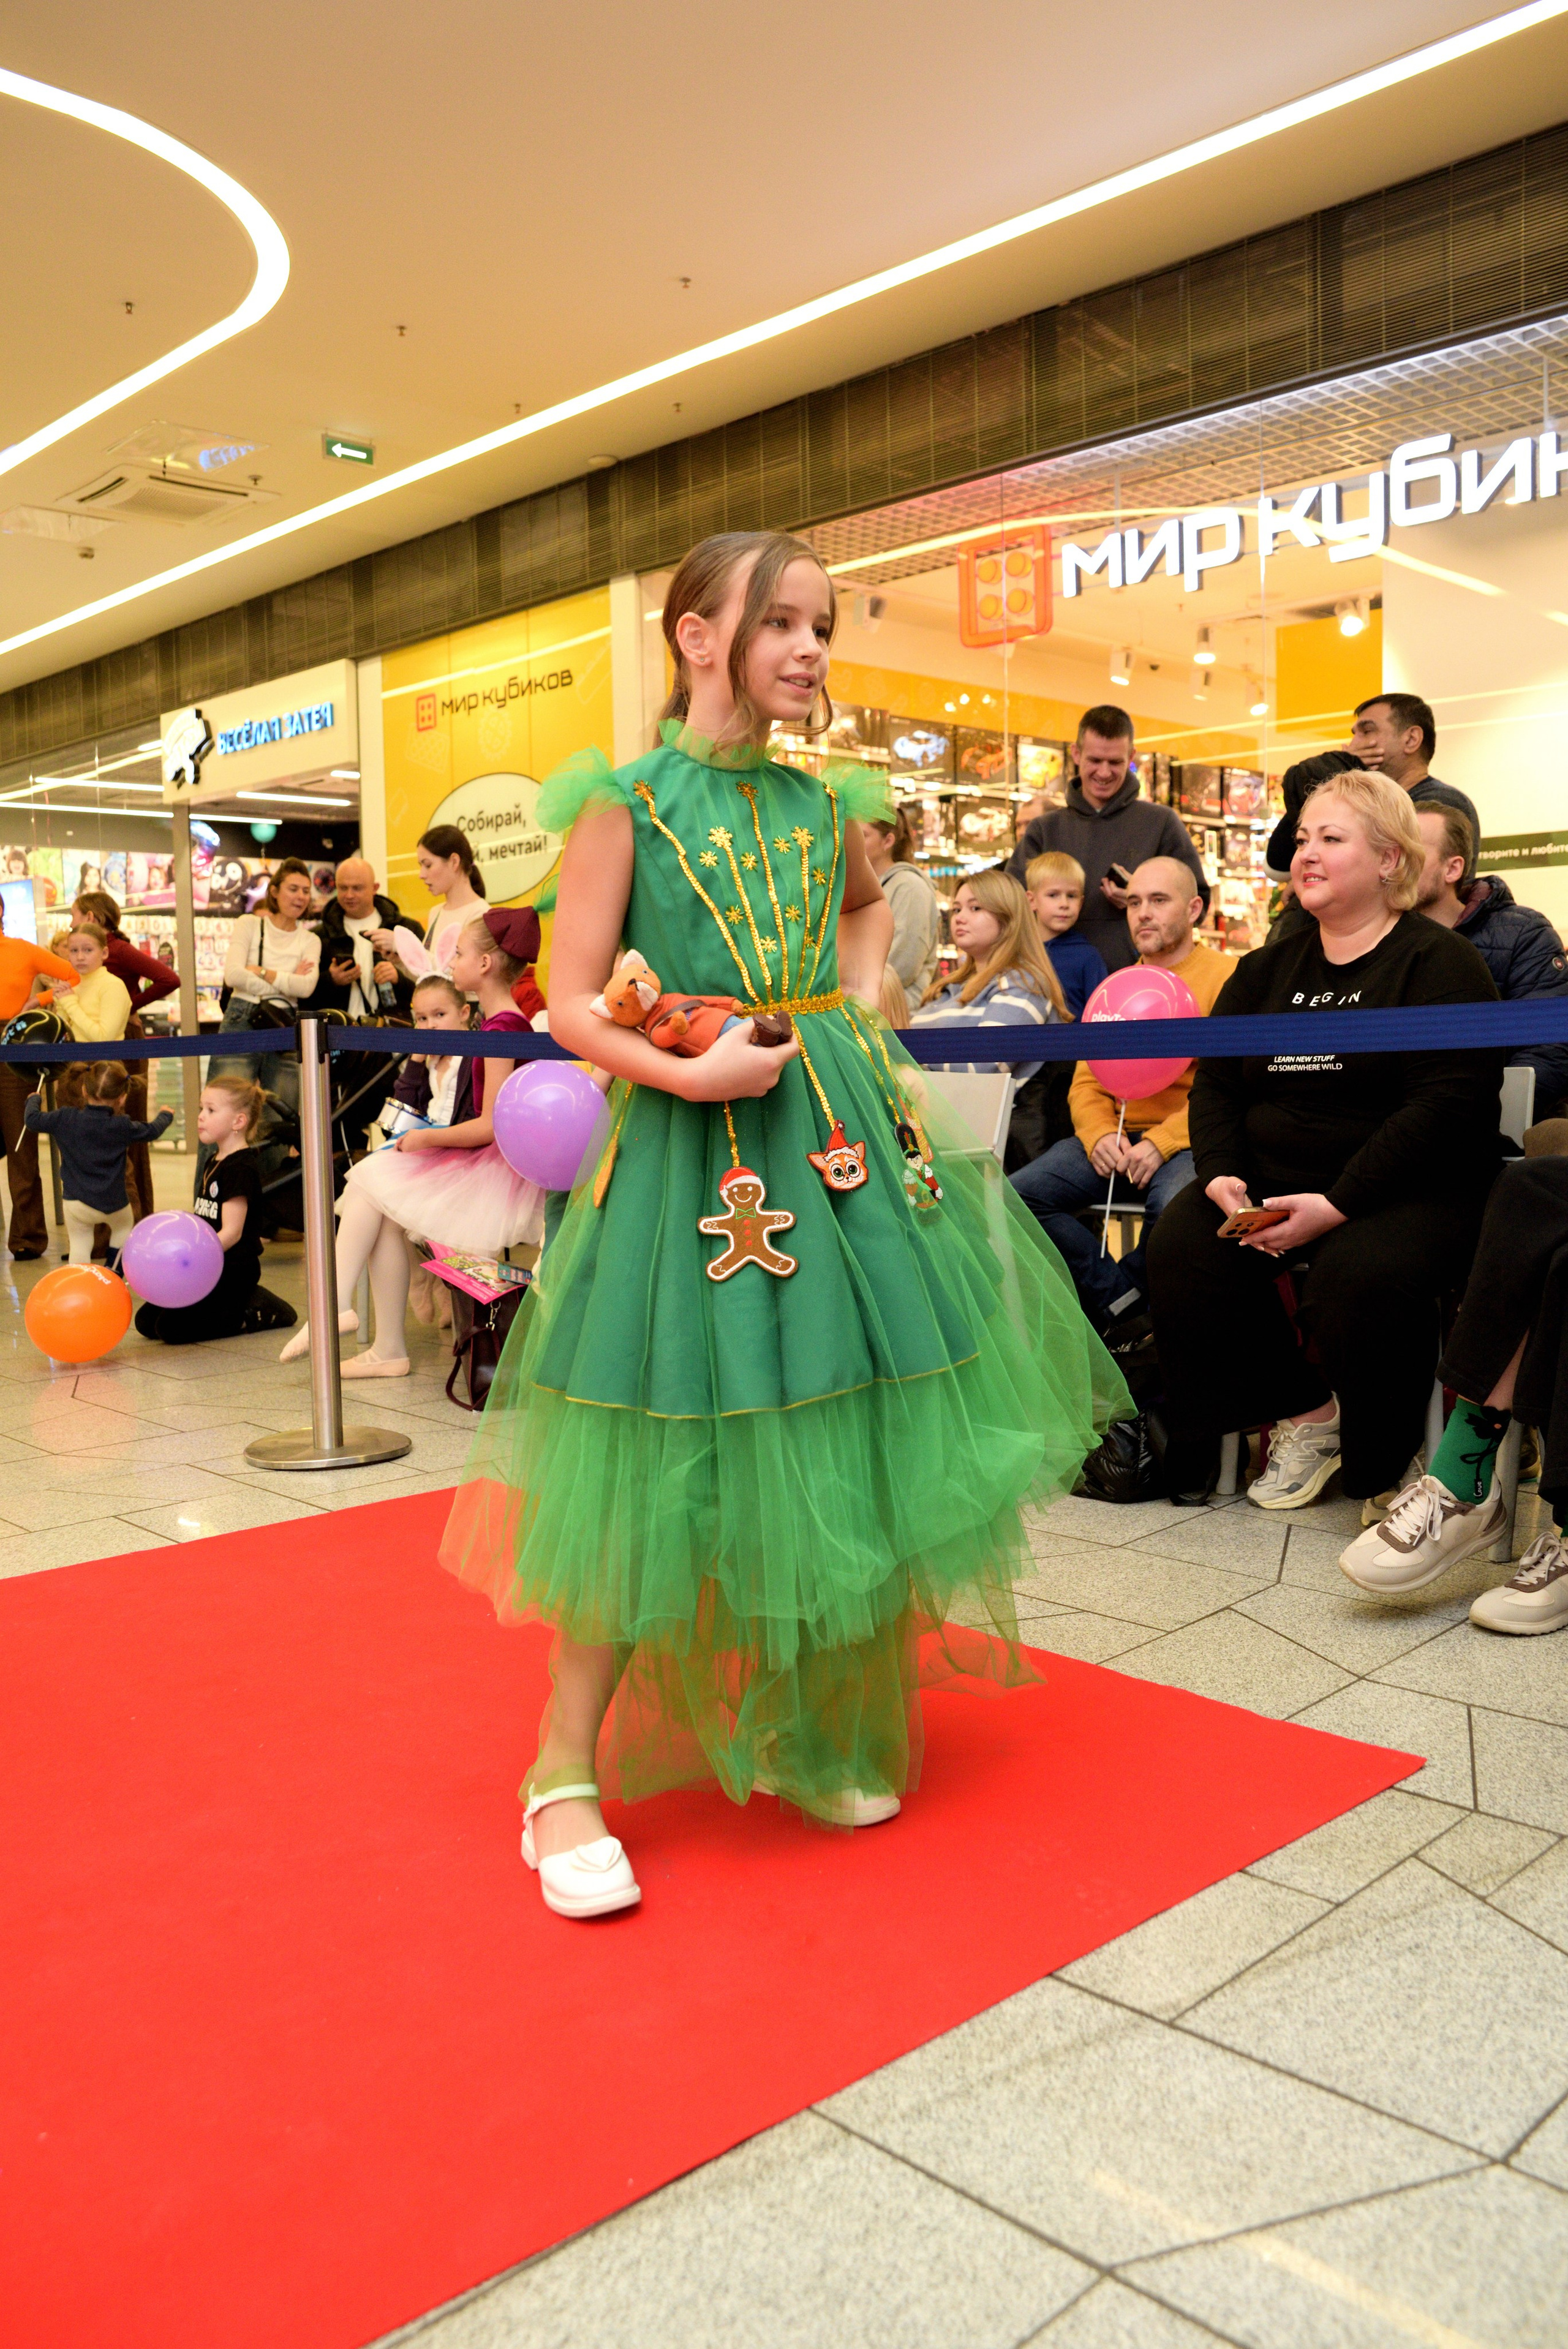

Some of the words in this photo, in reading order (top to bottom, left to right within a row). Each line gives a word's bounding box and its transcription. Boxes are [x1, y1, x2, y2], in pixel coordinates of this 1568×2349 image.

[1062, 508, 1242, 598] мир
[442, 693, 478, 715] мир
[483, 669, 573, 709] кубиков
[217, 715, 282, 755] ВЕСЁЛАЯ
[282, 701, 334, 739] ЗАТЕЯ
[457, 802, 526, 832] Собирай,
[489, 835, 547, 860] мечтай!
[1521, 848, 1529, 856] и
[1292, 990, 1362, 1006] BEGIN
